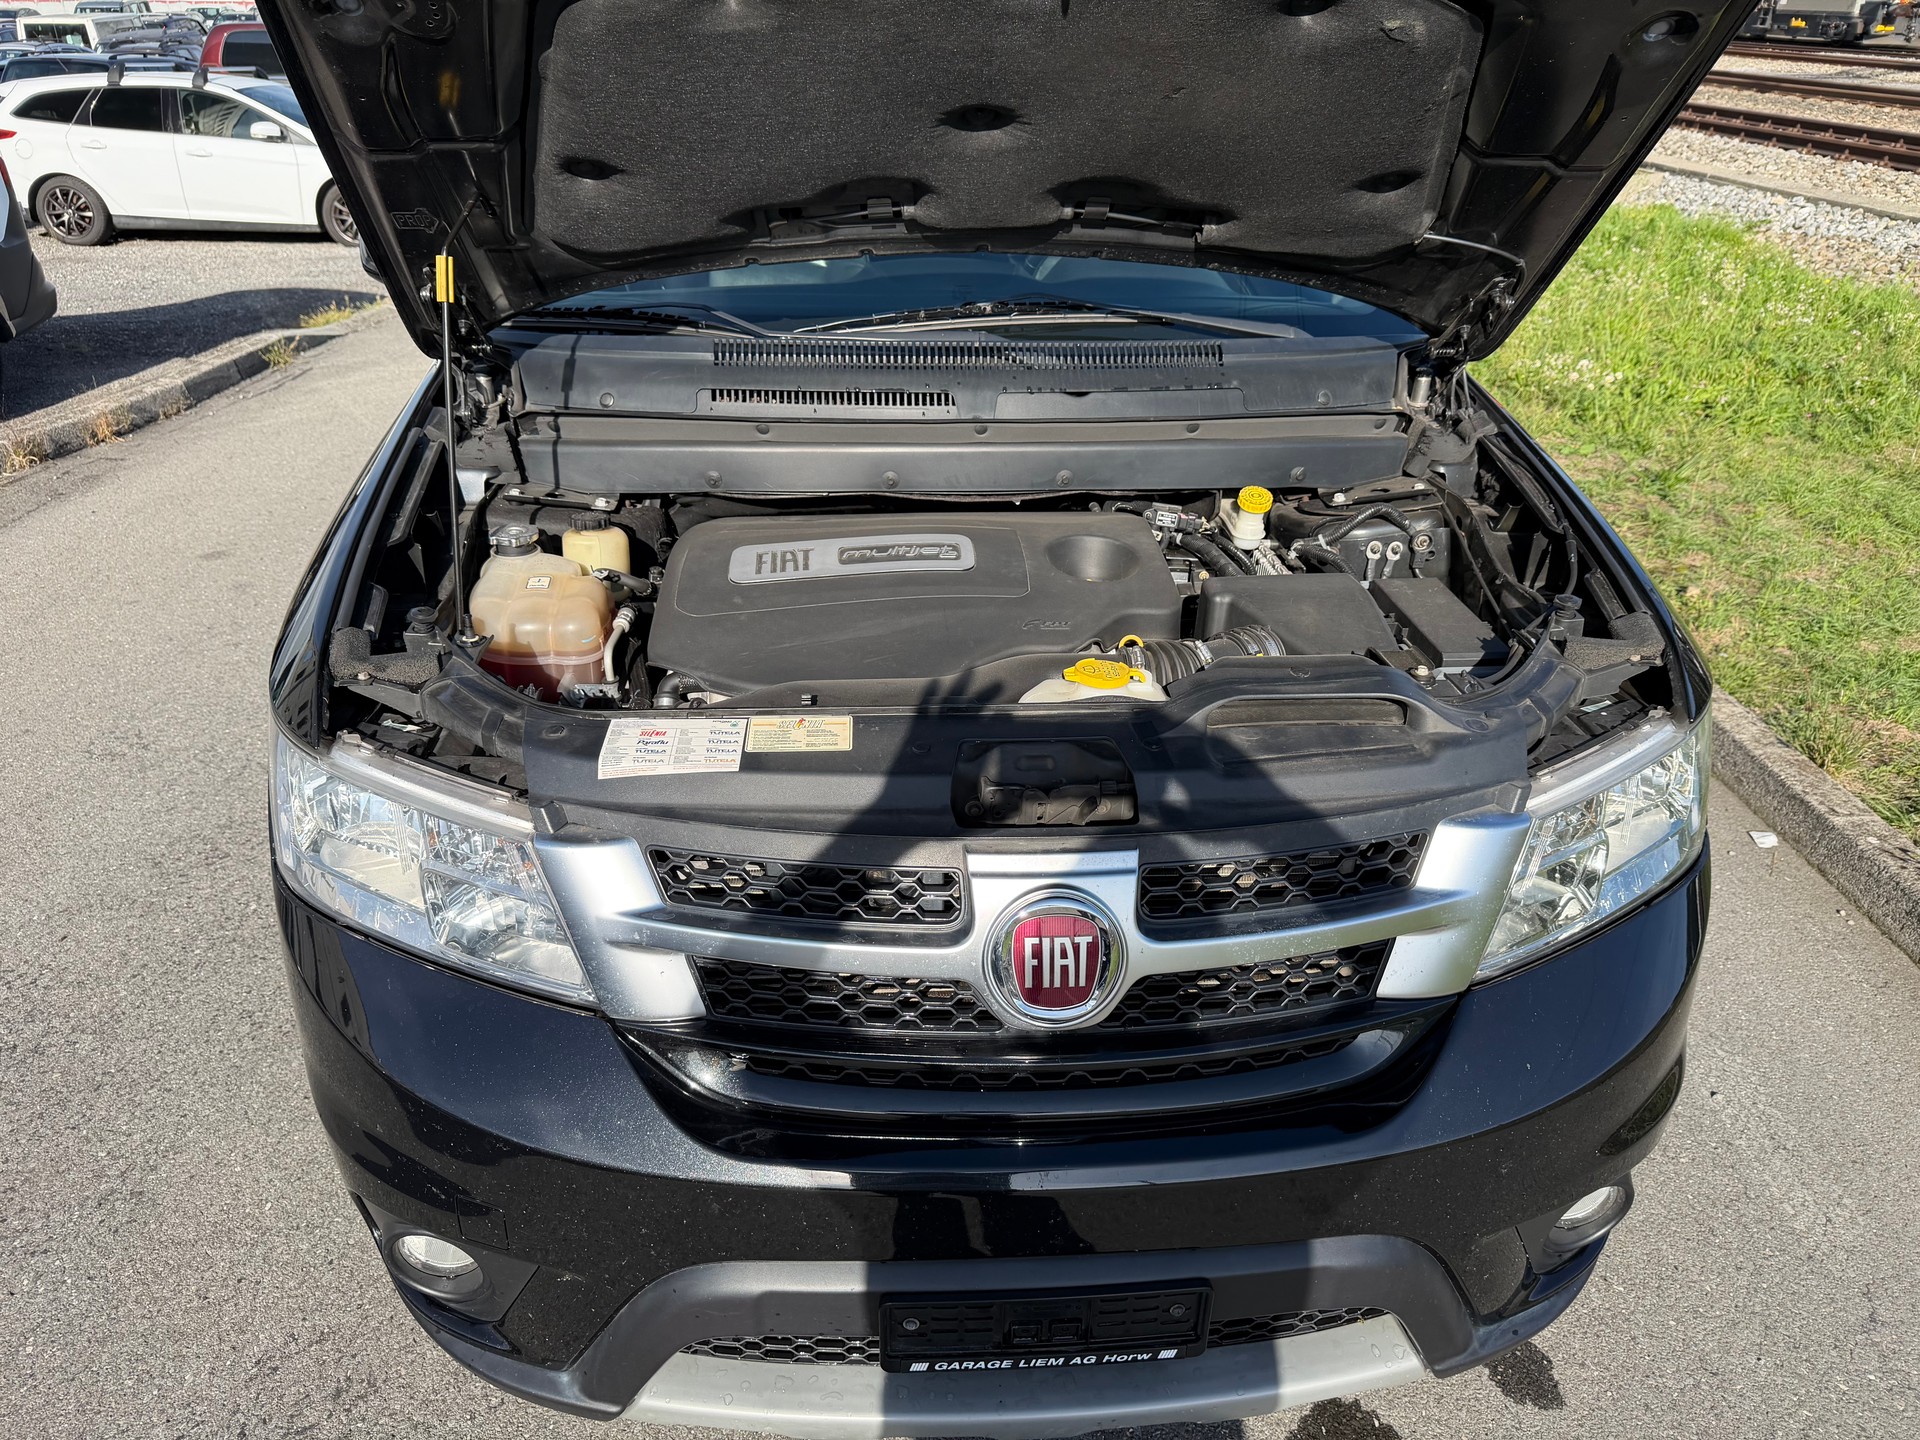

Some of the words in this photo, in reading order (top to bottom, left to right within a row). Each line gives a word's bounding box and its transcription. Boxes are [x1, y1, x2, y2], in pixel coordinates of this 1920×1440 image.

[396, 214, 431, 227] PROP
[754, 547, 815, 575] FIAT
[639, 729, 668, 737] SELENIA
[1024, 935, 1093, 989] FIAT
[934, 1359, 1014, 1371] GARAGE
[1018, 1356, 1064, 1368] LIEM
[1068, 1354, 1097, 1365] AG
[1102, 1351, 1152, 1363] Horw
